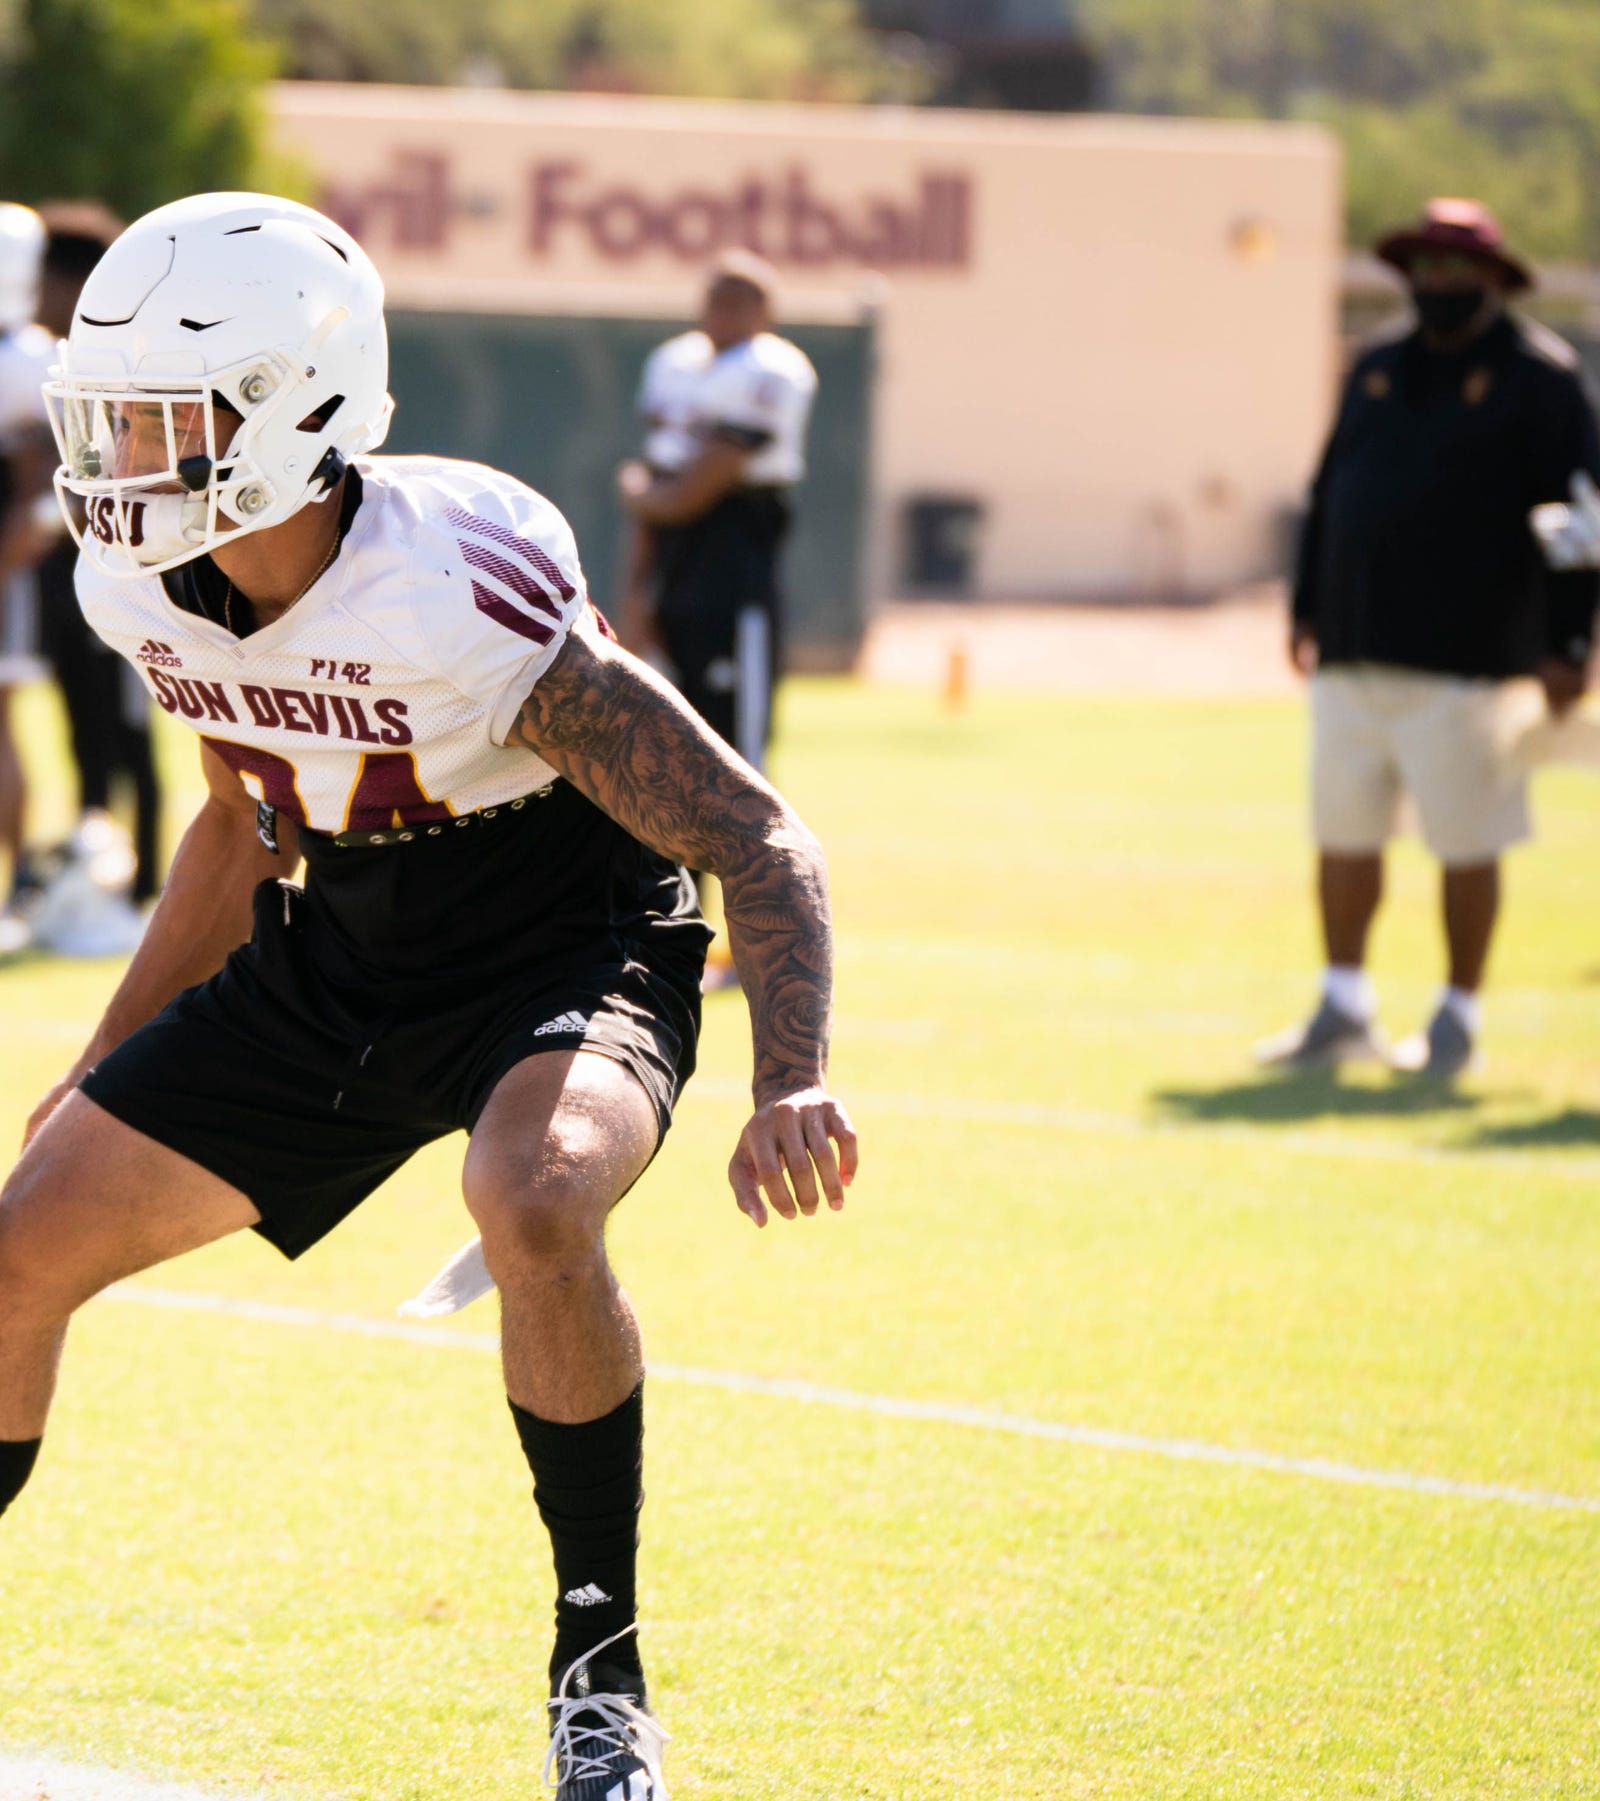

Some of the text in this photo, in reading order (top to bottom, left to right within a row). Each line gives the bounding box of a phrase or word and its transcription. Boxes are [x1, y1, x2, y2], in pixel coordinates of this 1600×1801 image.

[528, 160, 971, 265] Football
[147, 666, 413, 746] SUN DEVILS
